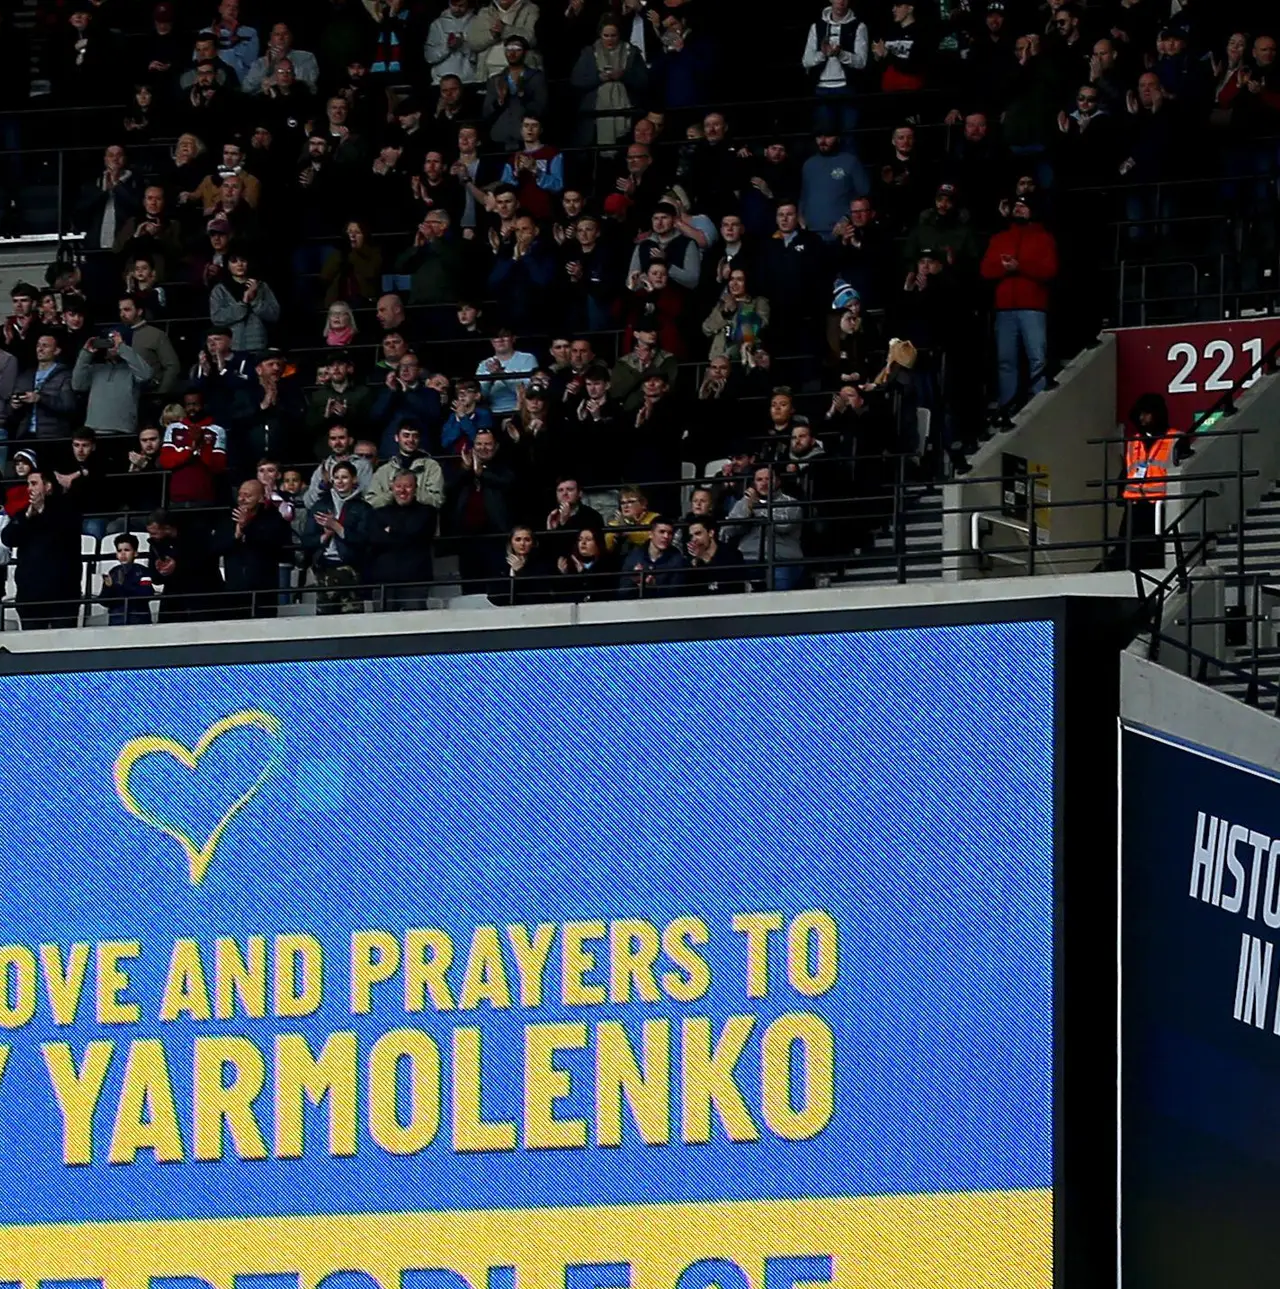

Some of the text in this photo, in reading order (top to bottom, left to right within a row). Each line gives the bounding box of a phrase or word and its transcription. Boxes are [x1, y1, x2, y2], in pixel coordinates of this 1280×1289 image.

[1167, 337, 1262, 394] 221
[1189, 810, 1280, 929] HISTO
[160, 933, 325, 1022] AND
[351, 917, 712, 1015] PRAYERS
[733, 910, 840, 998] TO
[1233, 932, 1274, 1030] IN
[43, 1012, 836, 1167] YARMOLENKO
